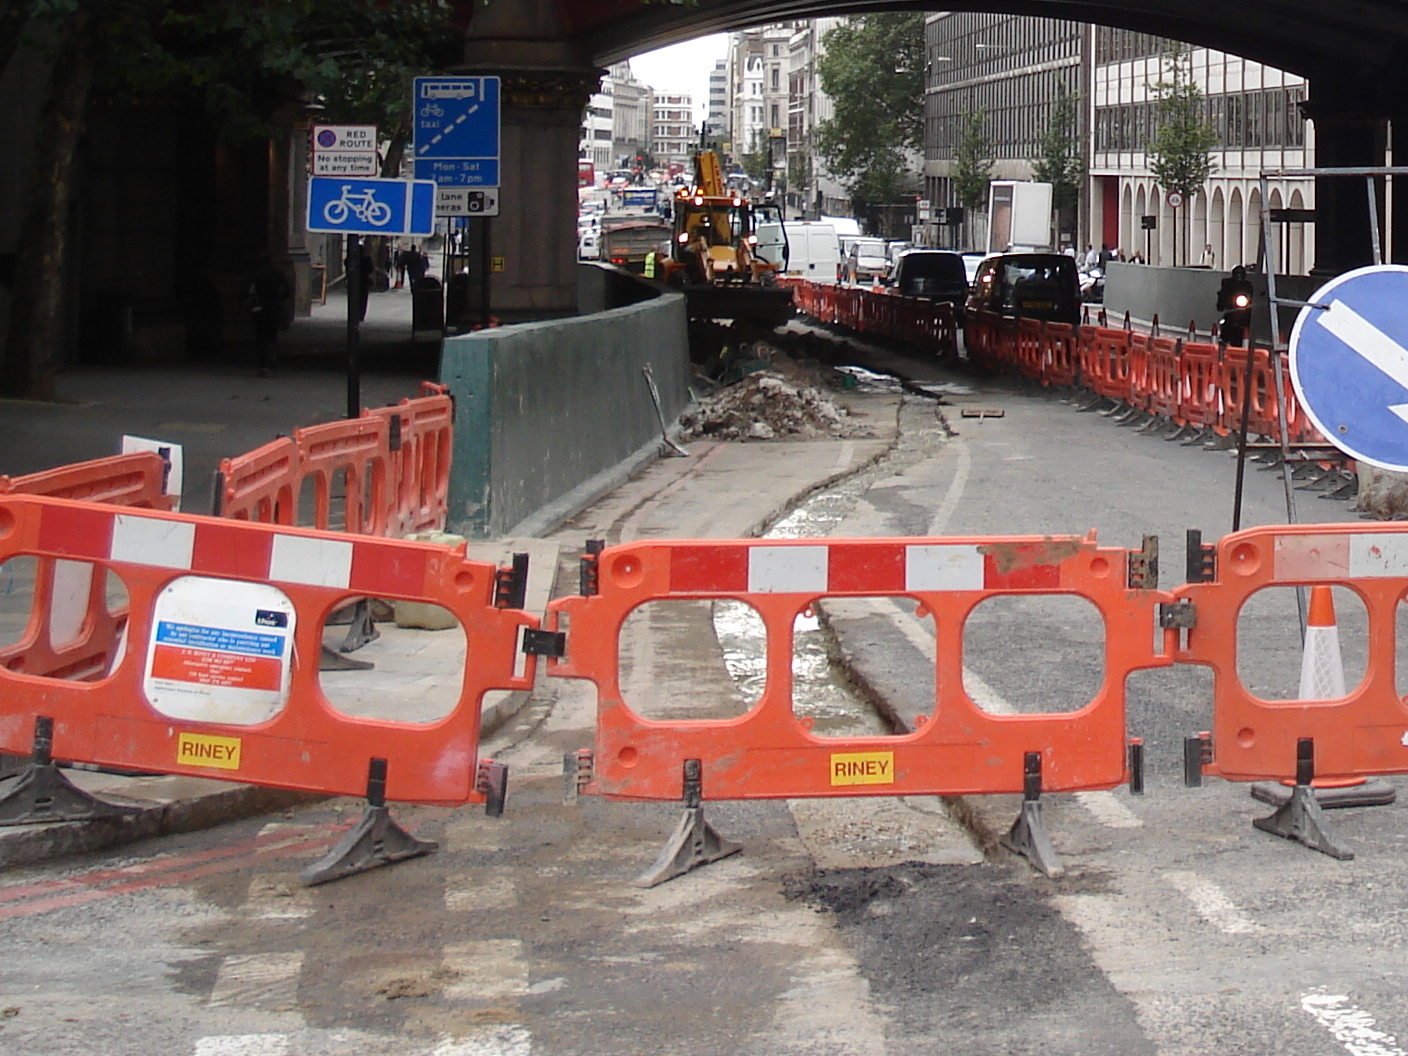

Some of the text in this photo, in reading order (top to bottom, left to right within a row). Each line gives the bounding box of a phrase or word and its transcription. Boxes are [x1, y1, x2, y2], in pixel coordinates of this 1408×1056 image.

[421, 120, 440, 128] taxi
[340, 140, 373, 148] ROUTE
[334, 155, 372, 164] stopping
[320, 164, 329, 172] at
[350, 164, 370, 172] time
[433, 162, 455, 171] Mon
[463, 162, 480, 171] Sat
[182, 741, 236, 760] RINEY
[835, 760, 889, 777] RINEY
